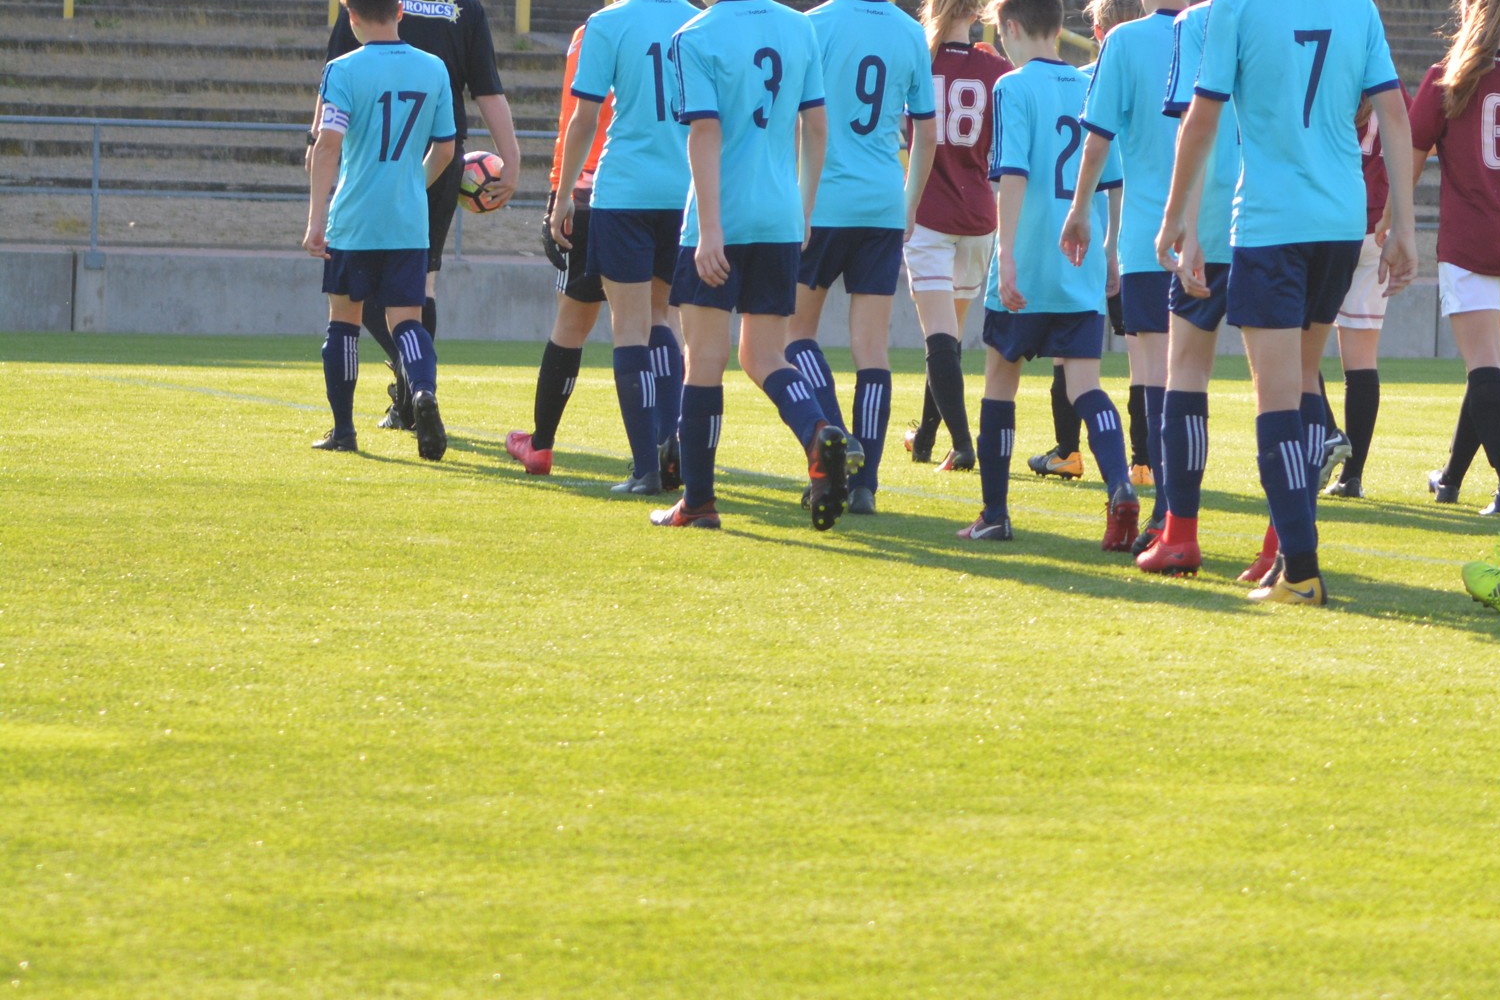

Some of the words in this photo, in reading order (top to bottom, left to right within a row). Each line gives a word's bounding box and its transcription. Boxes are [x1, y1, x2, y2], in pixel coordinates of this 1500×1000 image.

[402, 0, 452, 16] RONICS
[646, 42, 681, 122] 1
[753, 47, 783, 130] 3
[850, 55, 887, 136] 9
[932, 75, 988, 148] 18
[1294, 29, 1332, 129] 7
[377, 91, 428, 162] 17
[1055, 115, 1082, 200] 2
